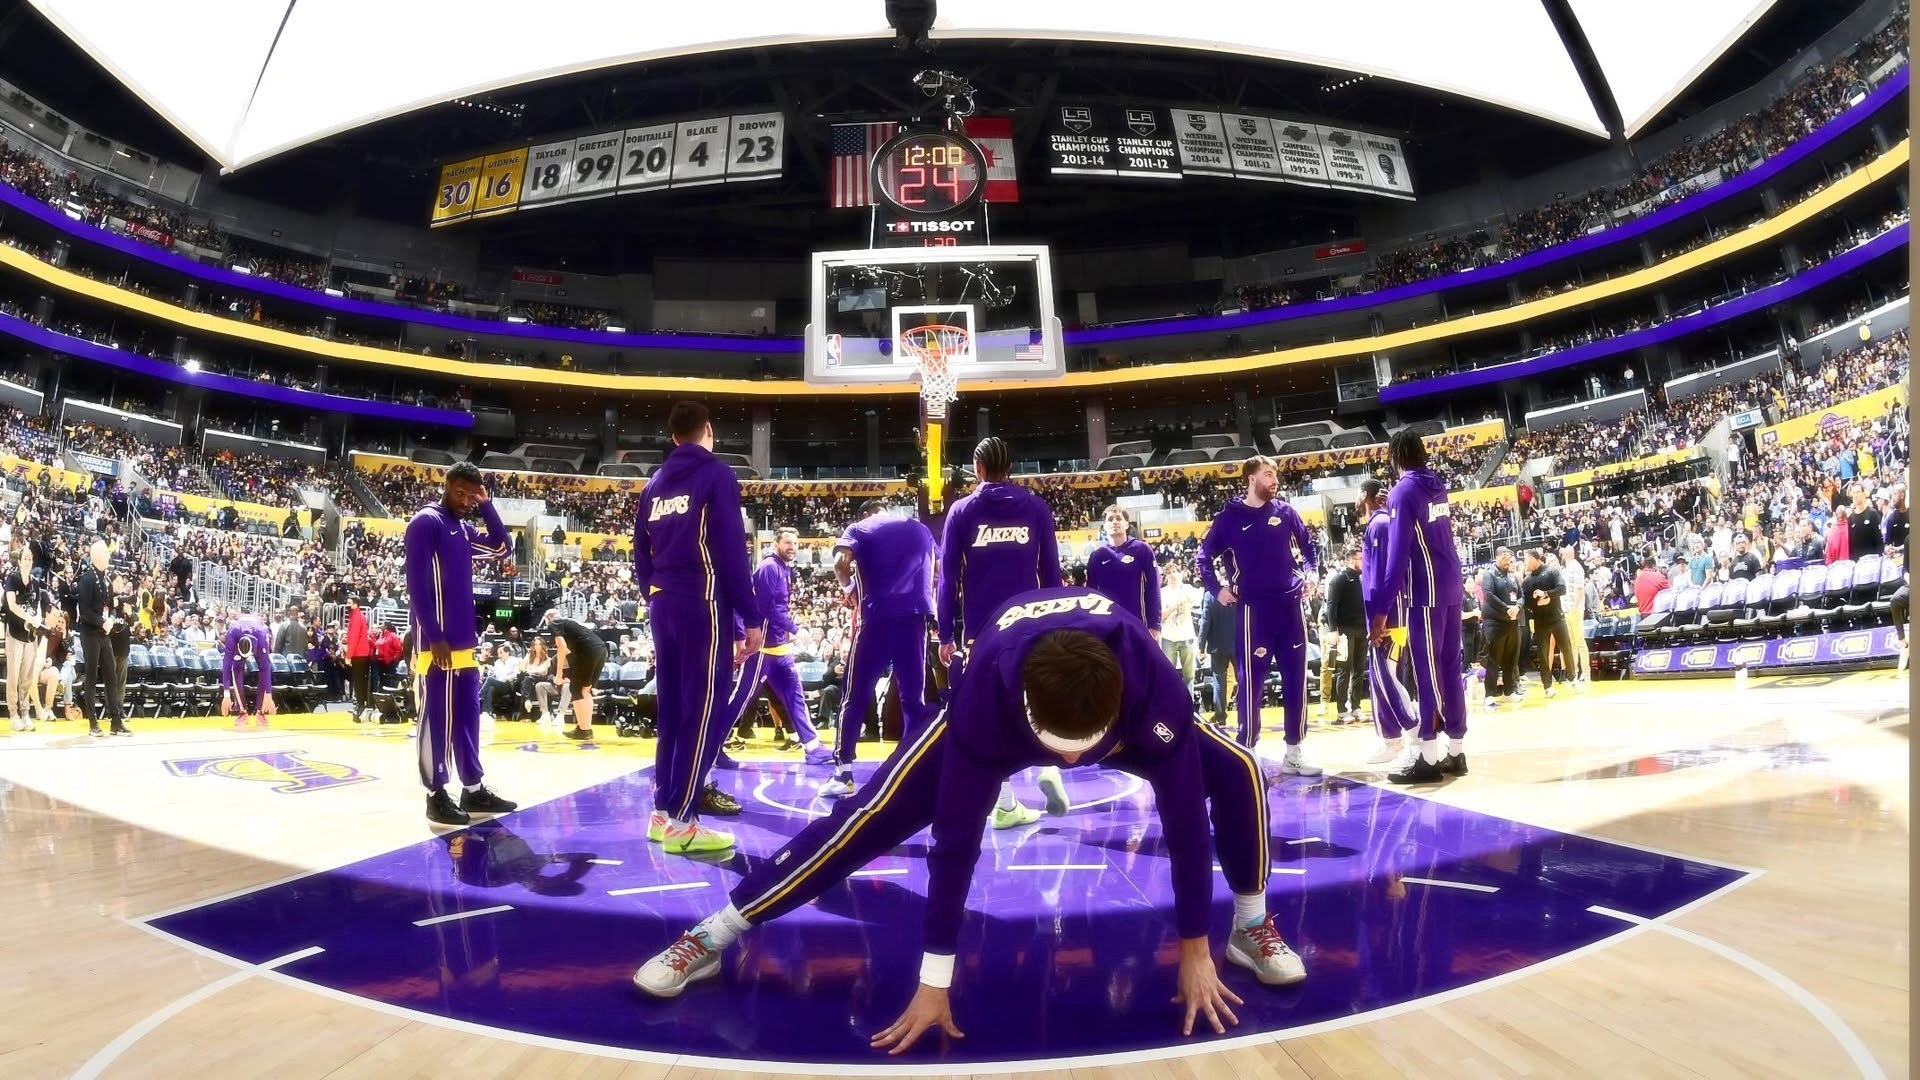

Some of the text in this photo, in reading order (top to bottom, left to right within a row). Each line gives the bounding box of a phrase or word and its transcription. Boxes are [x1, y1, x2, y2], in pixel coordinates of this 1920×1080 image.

[738, 120, 776, 131] BROWN
[626, 130, 673, 144] ROBITAILLE
[686, 126, 718, 137] BLAKE
[1184, 132, 1217, 140] WESTERN
[579, 138, 619, 151] GRETZKY
[1051, 135, 1109, 144] STANLEY CUP
[1117, 138, 1153, 146] STANLEY
[1181, 139, 1224, 148] CONFERENCE
[1235, 137, 1267, 145] WESTERN
[736, 135, 775, 163] 23
[1052, 143, 1110, 152] CHAMPIONS
[1119, 146, 1175, 156] CHAMPIONS
[1184, 146, 1223, 155] CHAMPIONS
[1232, 143, 1274, 153] CONFERENCE
[1283, 142, 1315, 152] CAMPBELL
[1367, 140, 1396, 152] MILLER
[535, 148, 567, 160] TAYLOR
[688, 141, 709, 167] 4
[905, 146, 963, 166] 12:00
[1236, 150, 1274, 159] CHAMPIONS
[1280, 148, 1320, 159] CONFERENCE
[488, 156, 520, 169] DIONNE
[625, 147, 667, 176] 20
[1061, 154, 1105, 165] 2013-14
[1129, 158, 1169, 168] 2011-12
[1191, 155, 1221, 164] 2013-14
[1243, 160, 1271, 169] 2011-12
[1284, 156, 1320, 166] CHAMPIONS
[576, 154, 615, 183] 99
[1290, 165, 1319, 175] 1992-93
[1330, 161, 1364, 172] CHAMPIONS
[531, 164, 560, 190] 18
[1336, 170, 1363, 180] 1990-91
[485, 172, 511, 199] 16
[900, 167, 958, 204] 24
[439, 180, 471, 210] 30
[911, 221, 975, 232] TISSOT
[1318, 447, 1388, 463] ANGELE
[78, 455, 112, 467] AMERICAN
[809, 483, 888, 493] LAKERS
[648, 495, 690, 521] LAKERS
[971, 524, 1030, 547] LAKERS
[496, 609, 512, 618] EXIT
